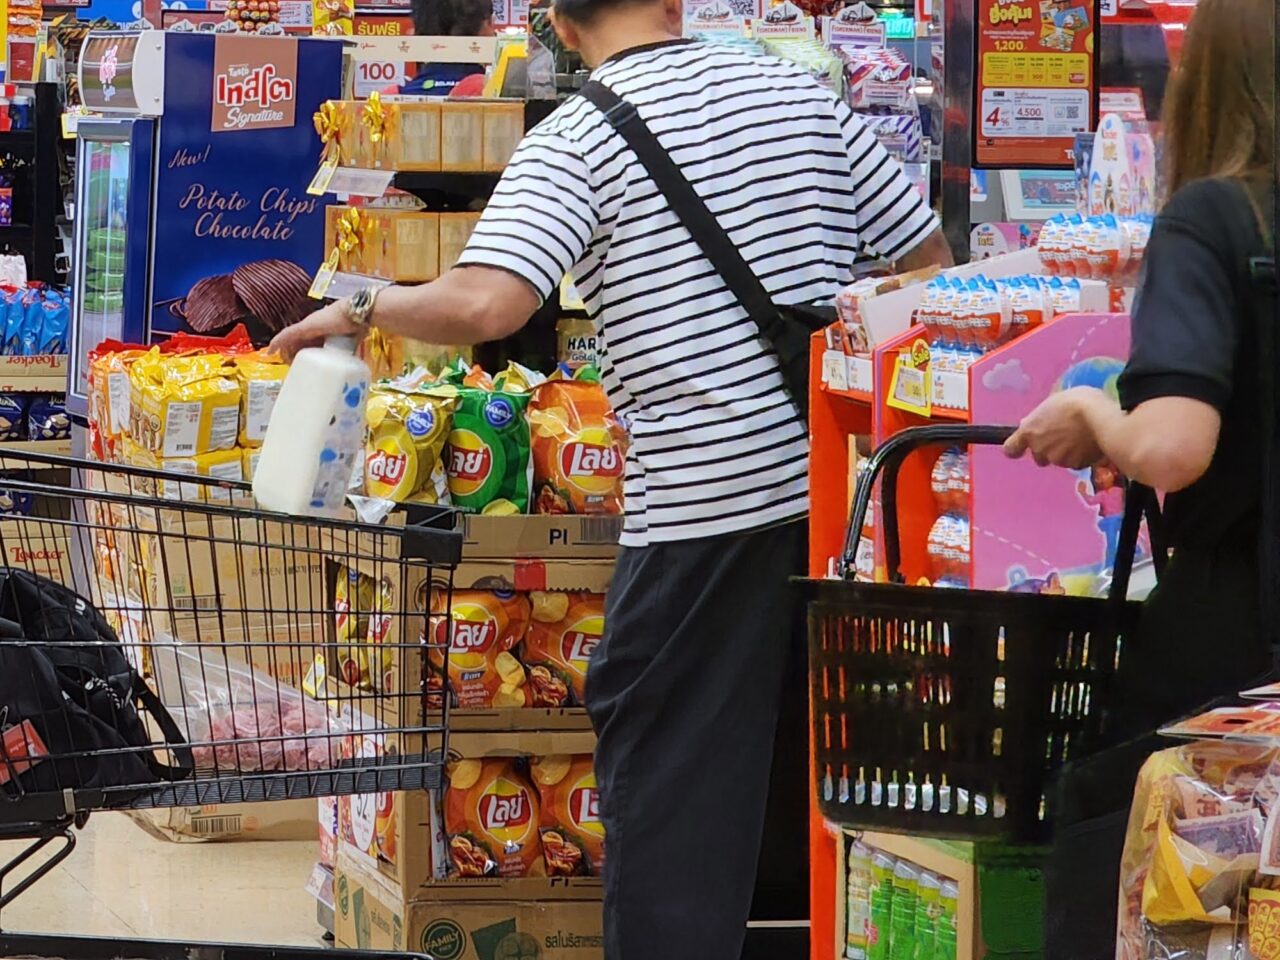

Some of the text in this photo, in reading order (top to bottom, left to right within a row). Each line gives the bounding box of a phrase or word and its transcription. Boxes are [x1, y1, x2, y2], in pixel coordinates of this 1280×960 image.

[994, 39, 1025, 52] 1,200
[359, 62, 395, 80] 100
[223, 107, 284, 128] Signature
[985, 106, 1001, 127] 4
[167, 143, 212, 169] New!
[178, 182, 317, 224] Potato Chips
[194, 211, 295, 241] Chocolate
[568, 444, 617, 477] เลย์
[448, 619, 490, 654] เลย์
[487, 793, 526, 829] เลย์
